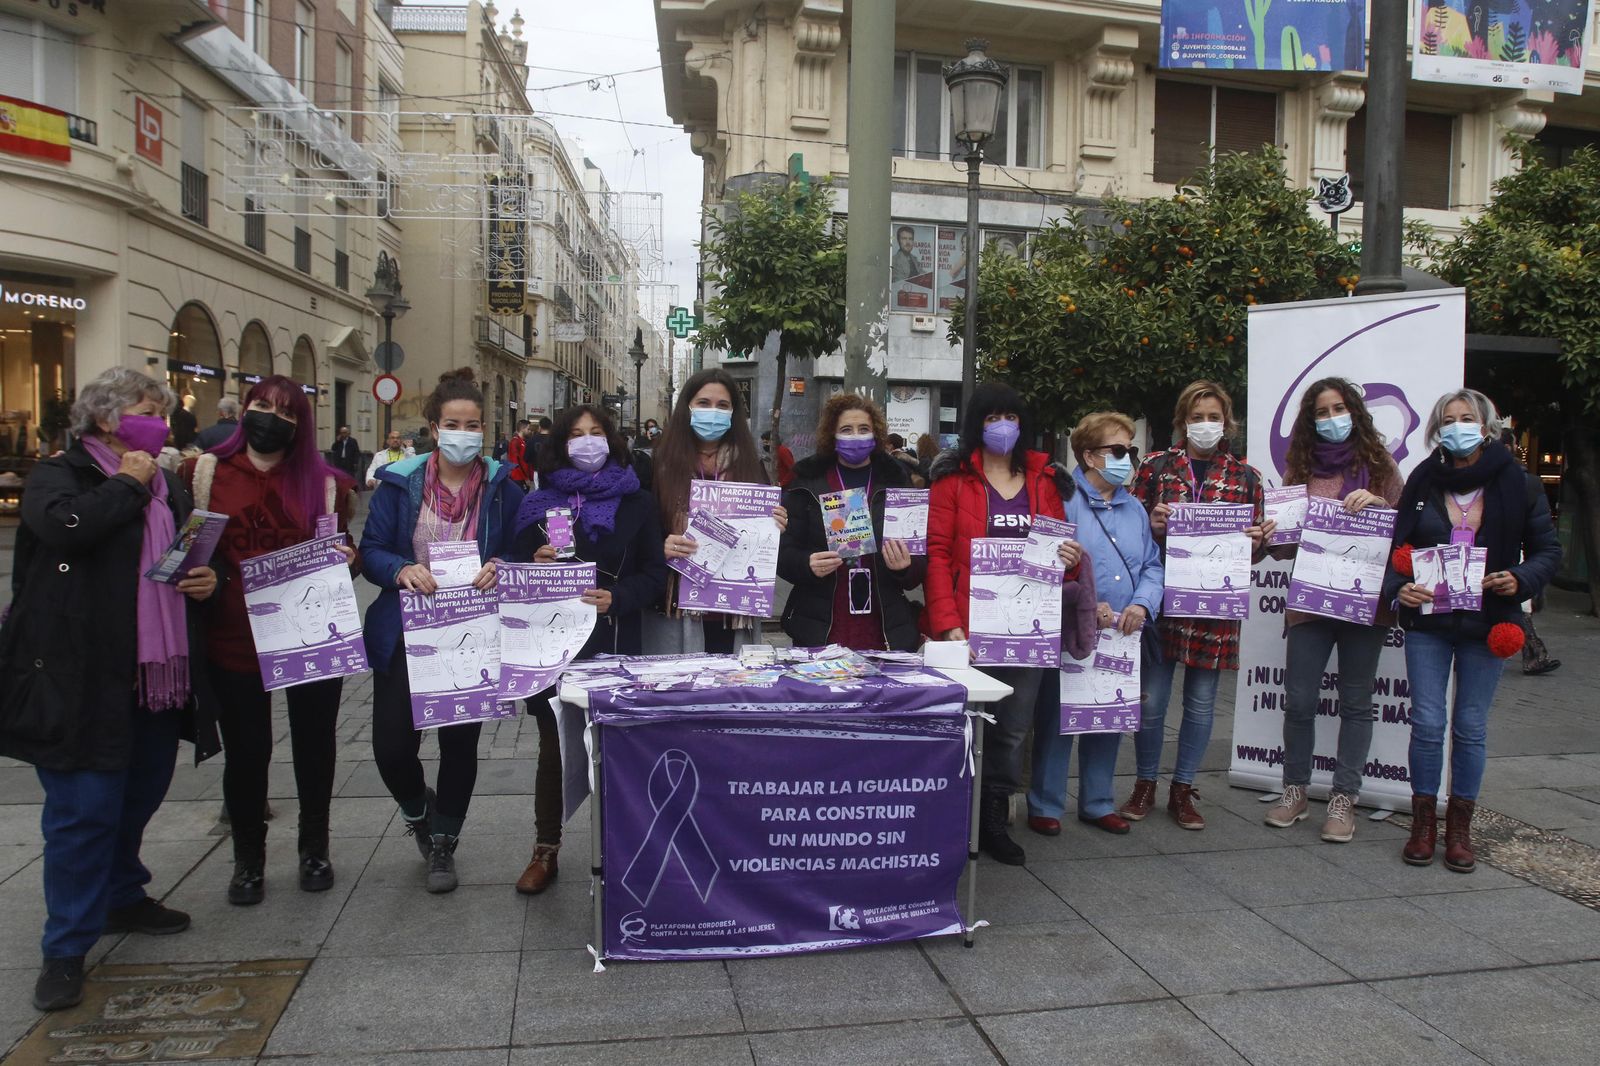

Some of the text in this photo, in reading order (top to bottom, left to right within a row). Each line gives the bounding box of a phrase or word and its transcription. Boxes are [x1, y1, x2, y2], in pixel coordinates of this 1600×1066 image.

[4, 291, 87, 310] MORENO
[691, 486, 719, 501] 21N
[721, 488, 780, 500] MARCHA EN BICI
[736, 504, 765, 512] MACHISTA
[752, 499, 780, 507] VIOLENCIA
[1308, 501, 1335, 518] 21N
[1195, 508, 1224, 516] MARCHA
[1380, 513, 1395, 522] BICI
[1335, 513, 1357, 522] CONTRA
[1366, 518, 1394, 529] VIOLENCIA
[1349, 522, 1377, 532] MACHISTA
[276, 538, 343, 562] MARCHA EN BICI
[972, 543, 998, 559] 21N
[276, 556, 302, 568] CONTRA
[296, 555, 328, 568] MACHISTA
[243, 558, 274, 579] 21N
[528, 569, 561, 577] MARCHA
[577, 569, 593, 577] BICI
[499, 569, 526, 586] 21N
[435, 589, 469, 601] MARCHA
[471, 588, 482, 597] EN
[402, 595, 433, 613] 21N
[435, 599, 461, 609] CONTRA
[455, 604, 486, 614] MACHISTA
[728, 778, 948, 795] TRABAJAR LA IGUALDAD
[761, 805, 916, 821] PARA CONSTRUIR
[768, 831, 906, 847] UN MUNDO SIN
[729, 853, 940, 872] VIOLENCIAS MACHISTAS
[862, 905, 897, 916] DIPUTACIÓN
[865, 907, 940, 925] DELEGACIÓN DE IGUALDAD
[698, 919, 737, 929] CORDOBESA
[733, 926, 747, 934] LAS
[747, 923, 776, 933] MUJERES
